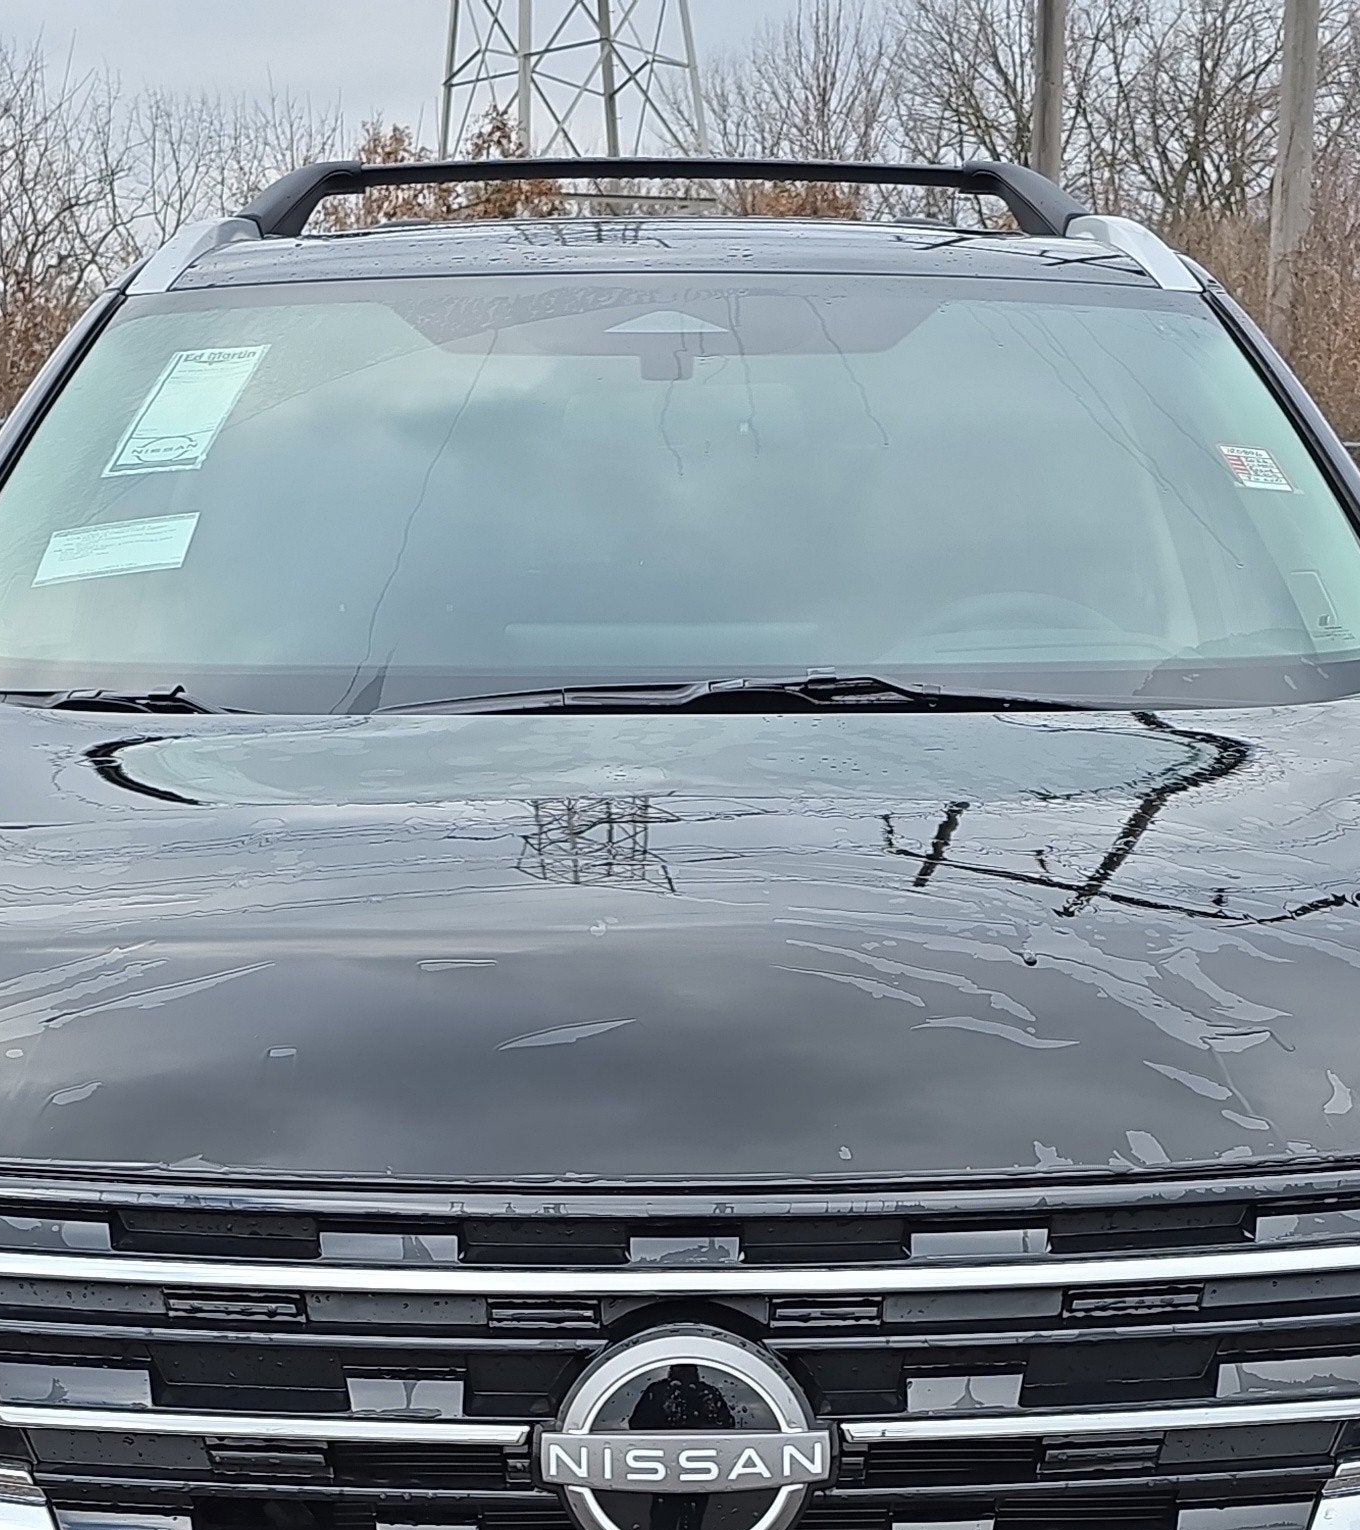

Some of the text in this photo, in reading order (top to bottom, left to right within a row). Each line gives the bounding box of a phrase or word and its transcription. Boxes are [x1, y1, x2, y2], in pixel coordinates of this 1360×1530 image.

[183, 352, 205, 362] Ed
[131, 442, 198, 456] NISSAN
[548, 1441, 823, 1482] NISSAN
